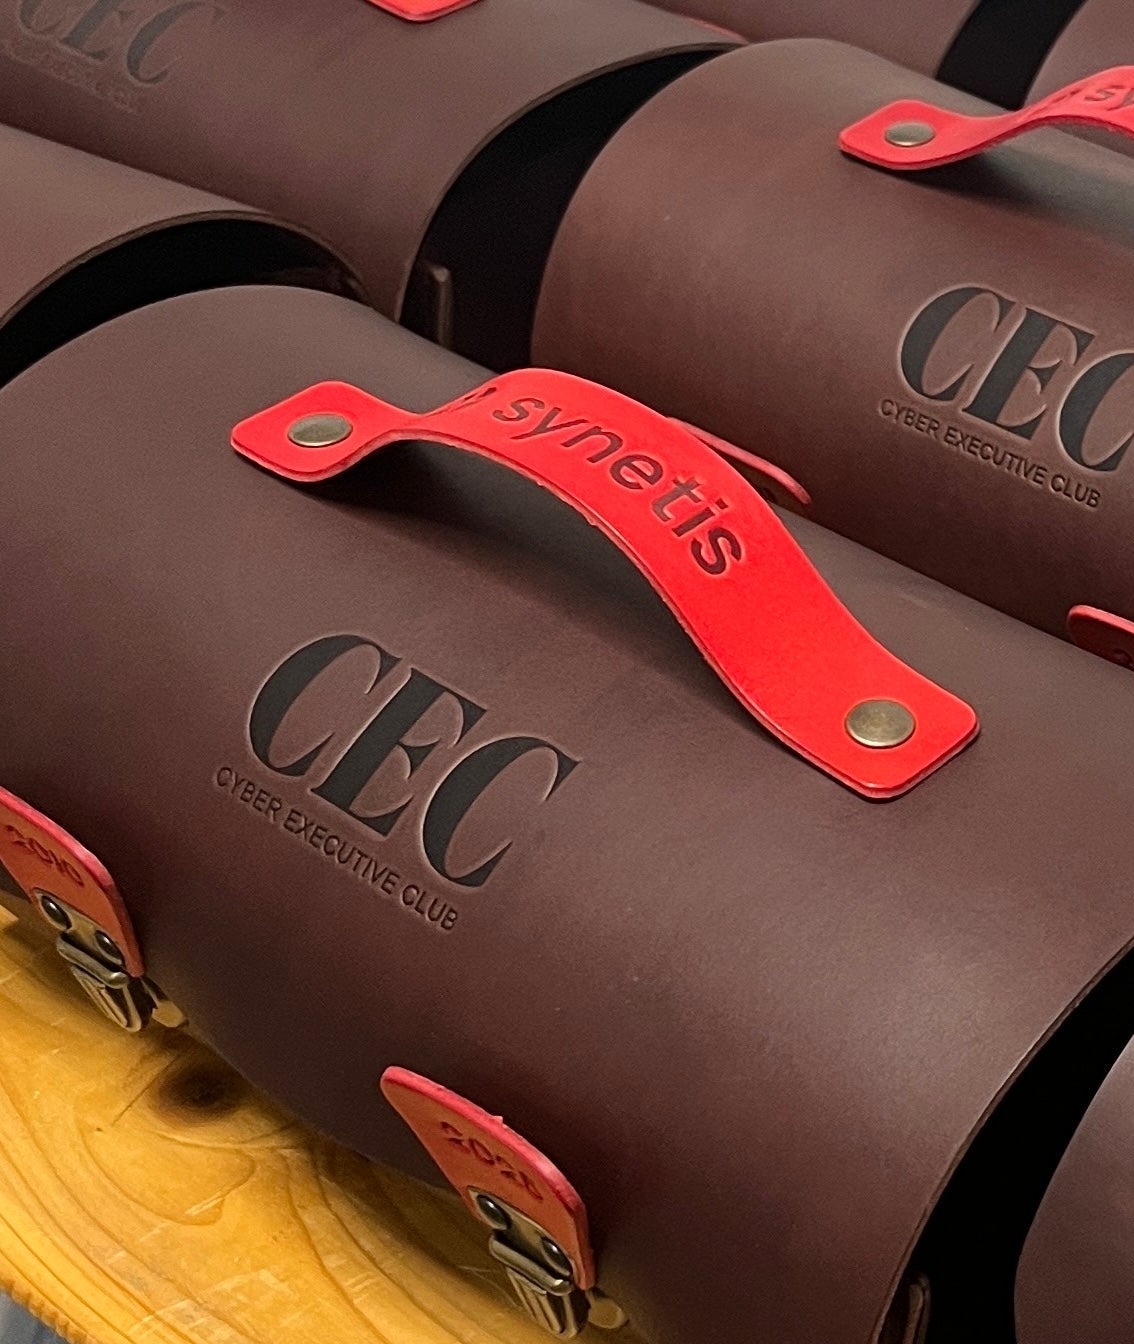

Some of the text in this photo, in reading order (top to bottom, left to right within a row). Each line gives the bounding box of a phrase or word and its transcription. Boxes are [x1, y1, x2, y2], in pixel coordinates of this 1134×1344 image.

[492, 397, 743, 576] synetis
[880, 398, 1101, 508] CYBER EXECUTIVE CLUB
[250, 633, 582, 888] CEC
[216, 766, 460, 932] CYBER EXECUTIVE CLUB
